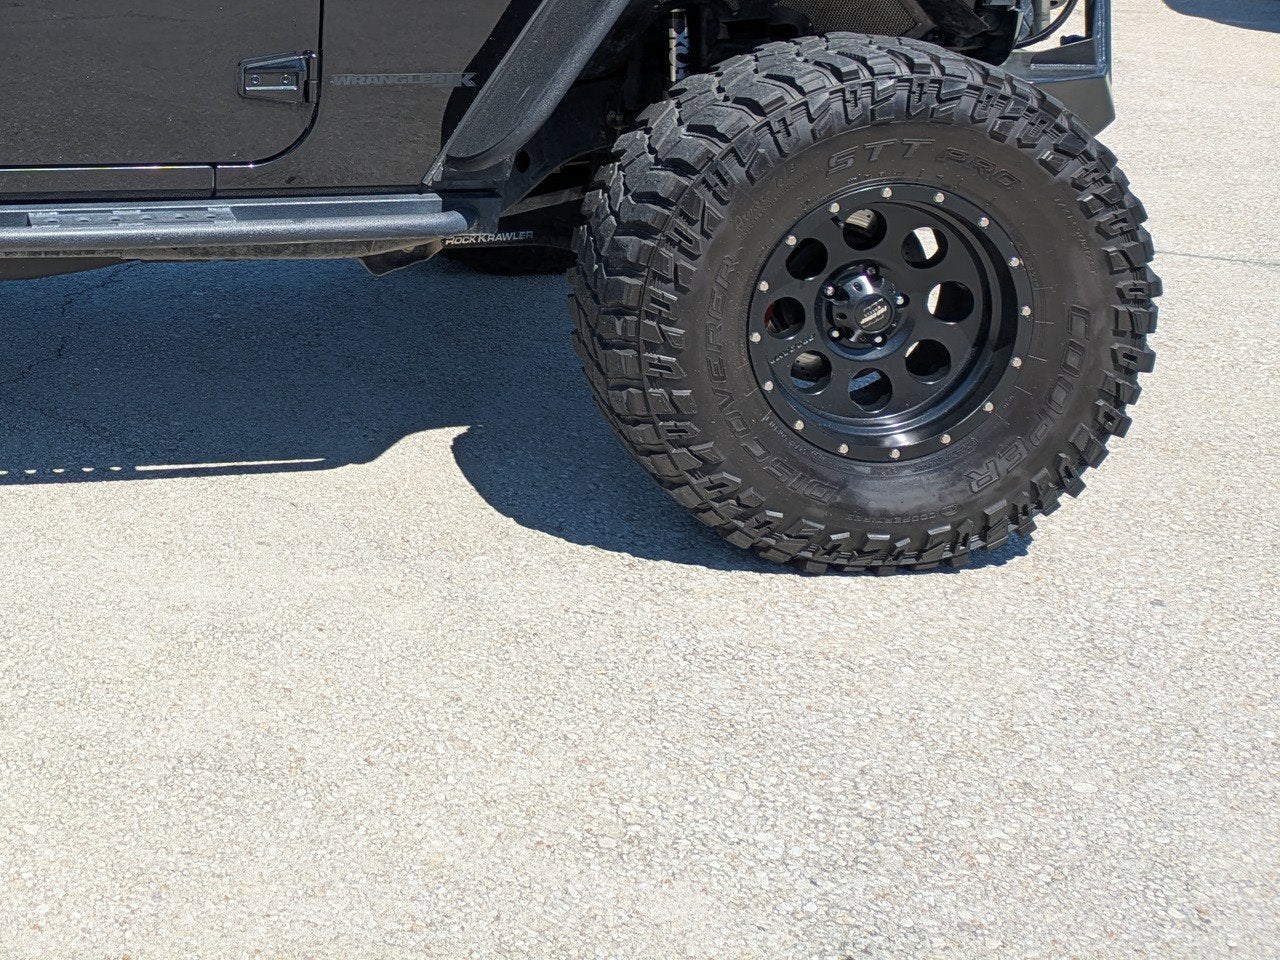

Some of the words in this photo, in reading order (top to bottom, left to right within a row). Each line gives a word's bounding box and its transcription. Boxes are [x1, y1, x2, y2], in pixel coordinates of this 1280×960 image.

[330, 73, 446, 86] WRANGLER
[825, 137, 937, 176] STT
[934, 144, 1023, 193] PRO
[703, 252, 841, 505] DISCOVERER
[963, 304, 1093, 498] COOPER
